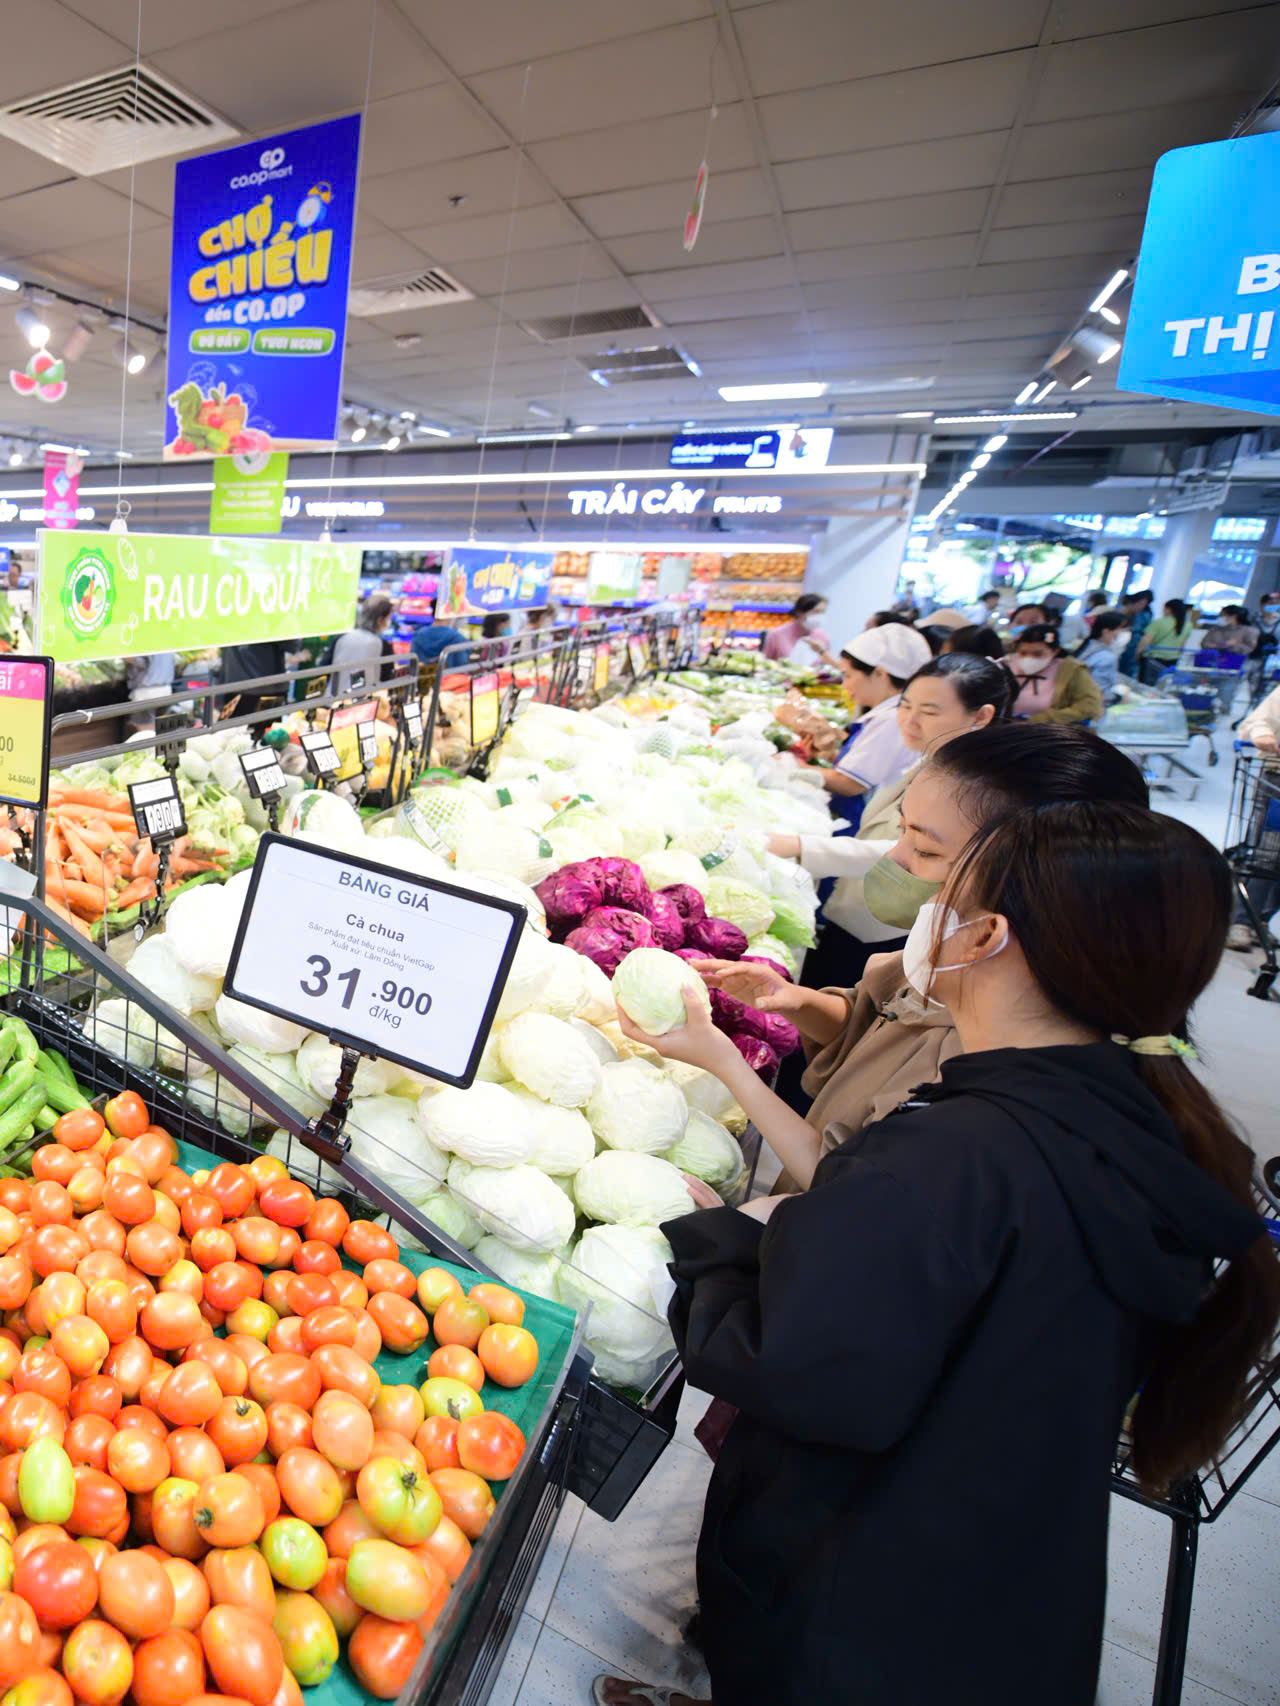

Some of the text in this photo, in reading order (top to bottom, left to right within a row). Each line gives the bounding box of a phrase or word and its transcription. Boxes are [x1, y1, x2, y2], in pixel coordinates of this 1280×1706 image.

[233, 292, 306, 325] CO.OP
[568, 483, 637, 514] TRÁI
[641, 482, 705, 514] CÂY
[143, 573, 209, 622] RAU
[338, 870, 429, 912] BẢNG GIÁ
[346, 913, 405, 942] Cà chua
[308, 921, 324, 932] Sản
[324, 926, 346, 940] phẩm
[347, 934, 360, 946] đạt
[376, 944, 401, 959] chuẩn
[403, 953, 435, 971] VietGap
[331, 939, 349, 952] Xuất
[364, 951, 382, 963] Lâm
[383, 957, 405, 972] Đồng
[300, 954, 433, 1016] 31 .900
[368, 1005, 402, 1029] đ/kg
